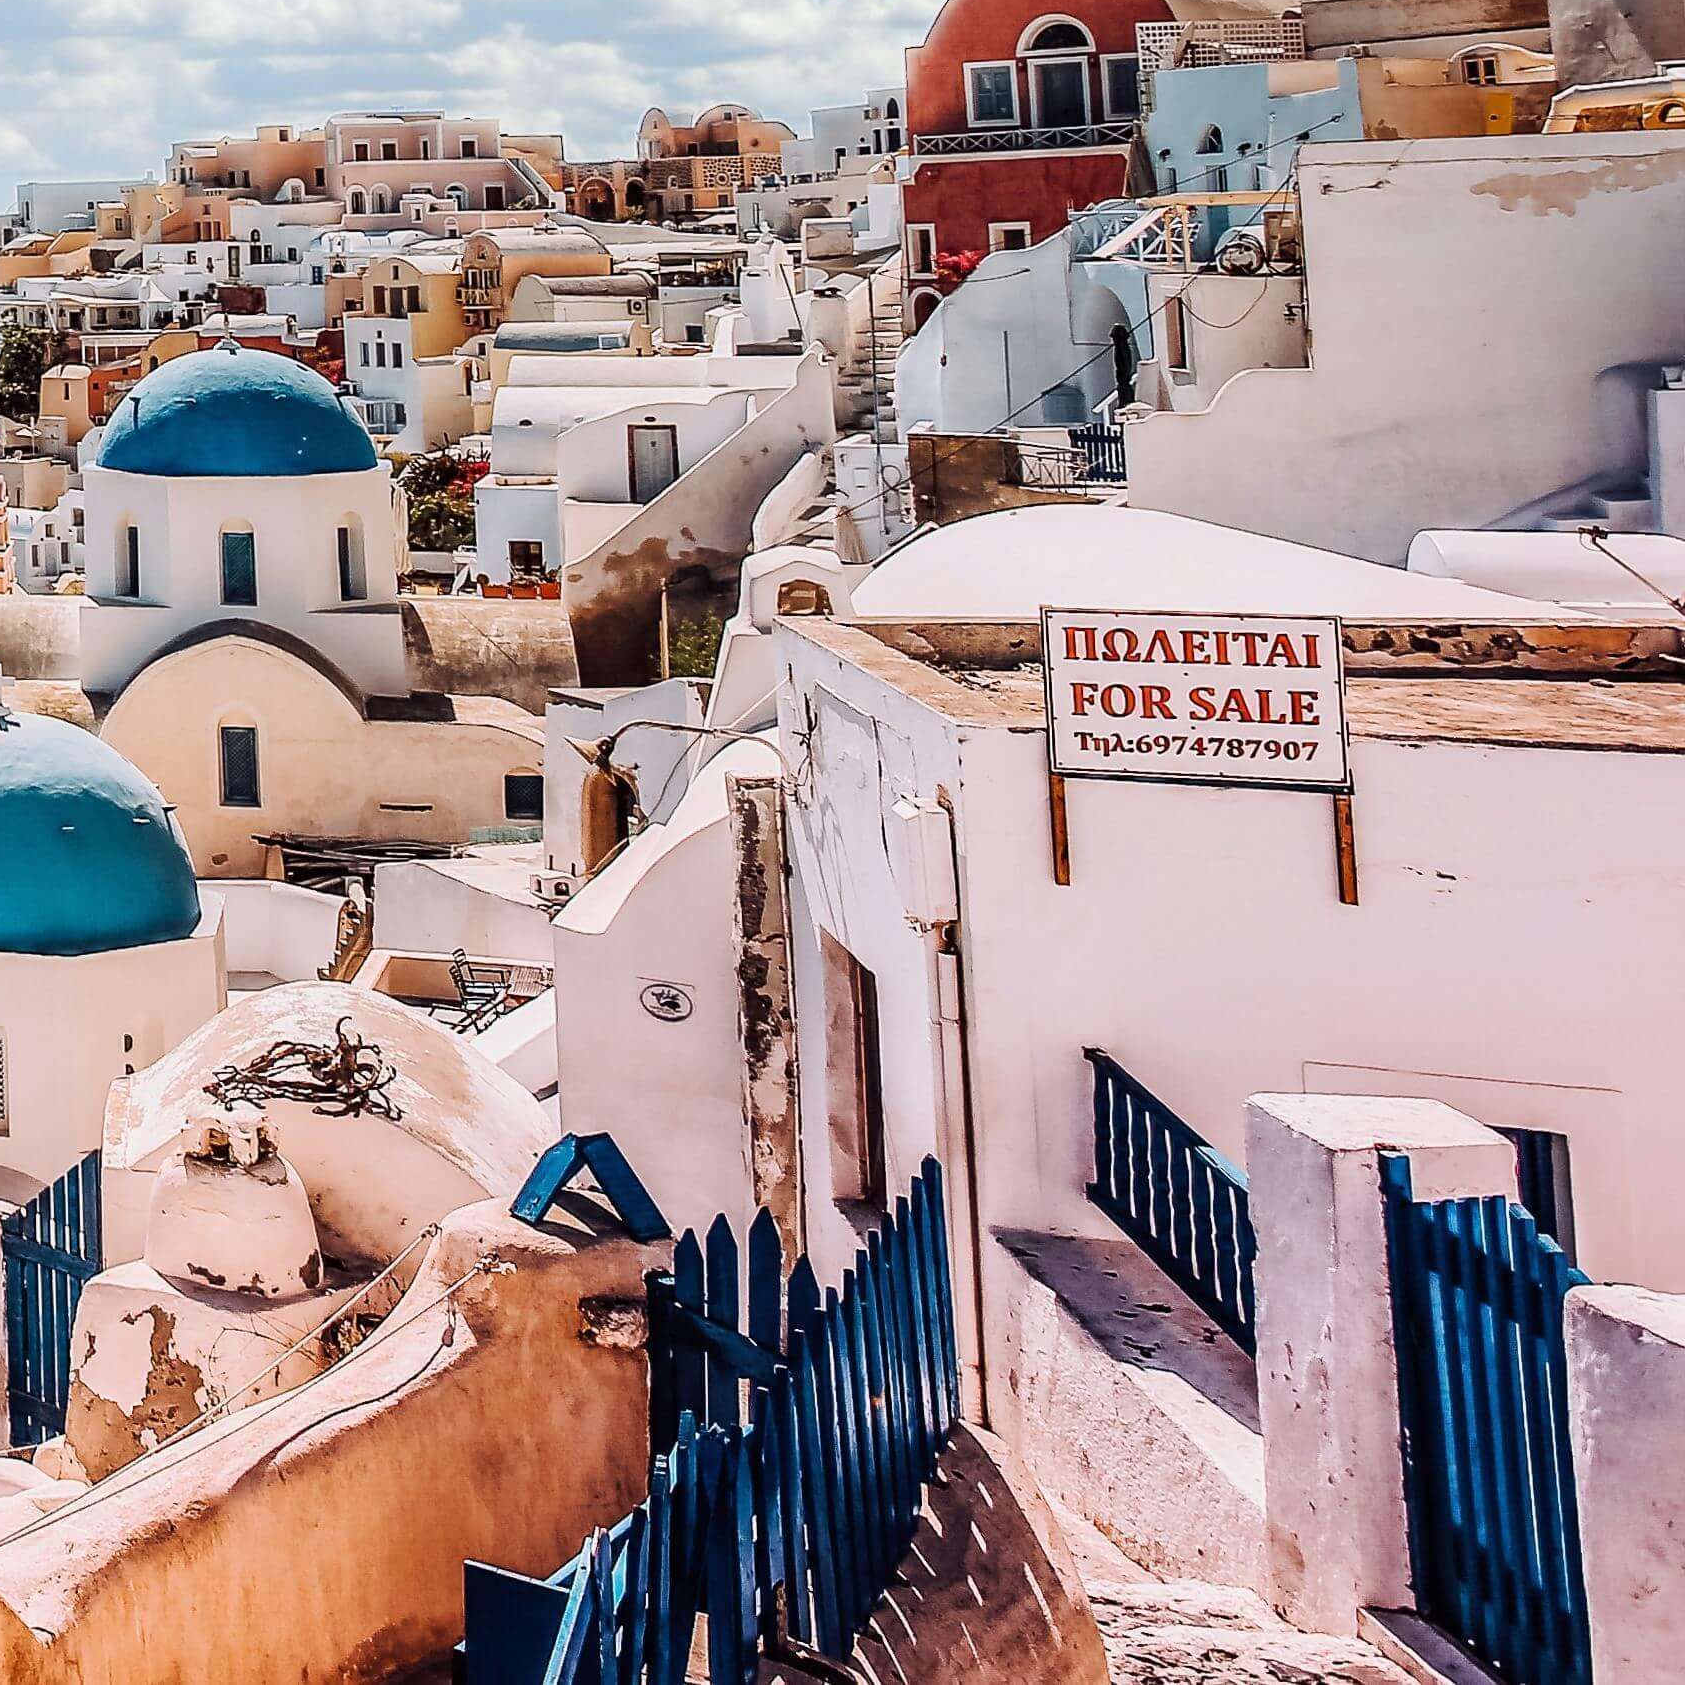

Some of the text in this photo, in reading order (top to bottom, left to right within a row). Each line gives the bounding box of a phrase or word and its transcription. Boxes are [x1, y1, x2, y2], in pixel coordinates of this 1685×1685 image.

[1062, 626, 1322, 668] ΠΩΛΕΙΤΑΙ
[1069, 682, 1320, 725] FOR SALE
